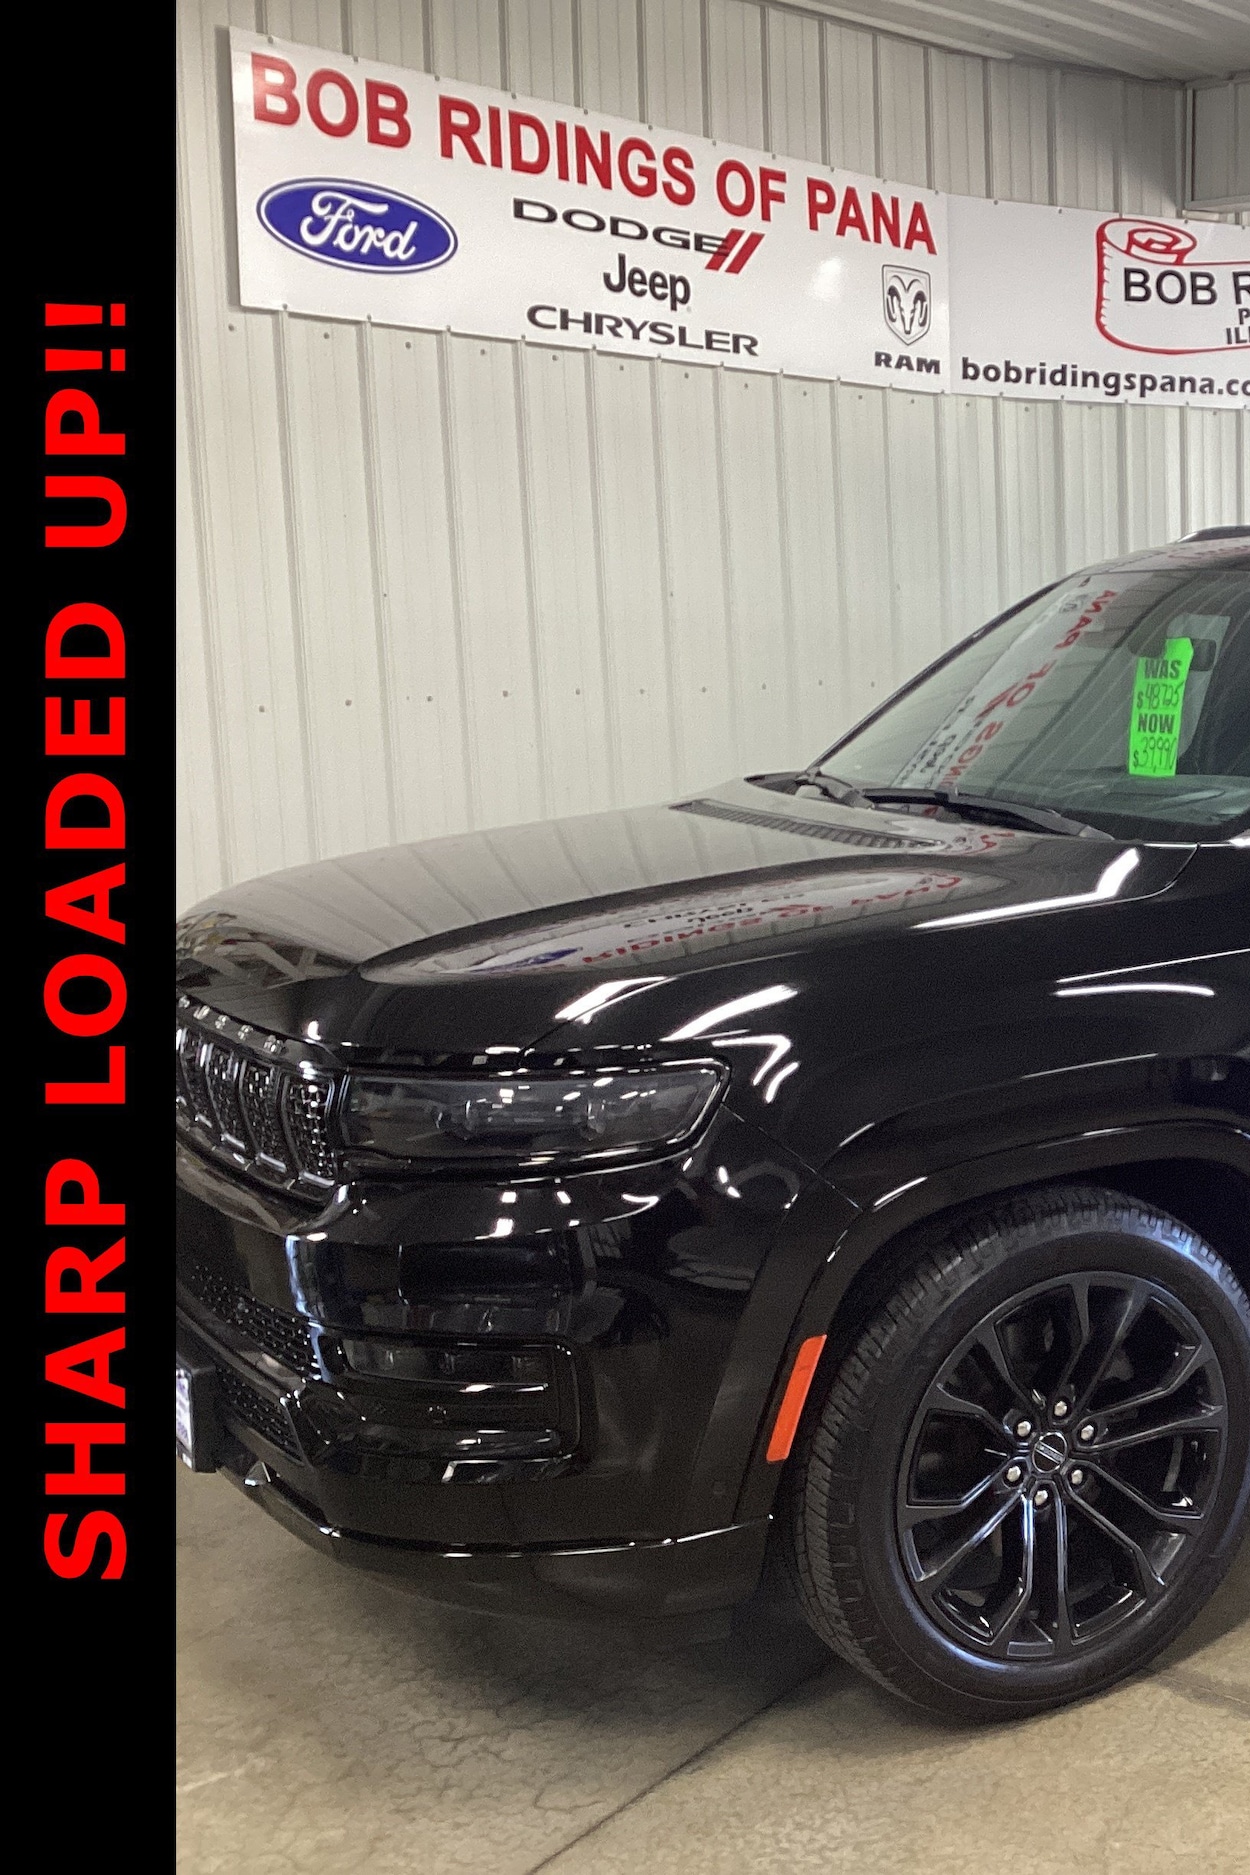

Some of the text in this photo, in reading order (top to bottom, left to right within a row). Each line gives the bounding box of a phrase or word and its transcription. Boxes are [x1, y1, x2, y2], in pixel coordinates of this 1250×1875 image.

[252, 51, 938, 256] BOB RIDINGS OF PANA
[299, 190, 419, 261] Ford
[513, 197, 730, 257] DODGE
[602, 253, 692, 311] Jeep
[1123, 266, 1218, 305] BOB
[526, 304, 759, 357] CHRYSLER
[874, 351, 941, 375] RAM
[1144, 659, 1182, 679] WAS
[1137, 713, 1175, 734] NOW
